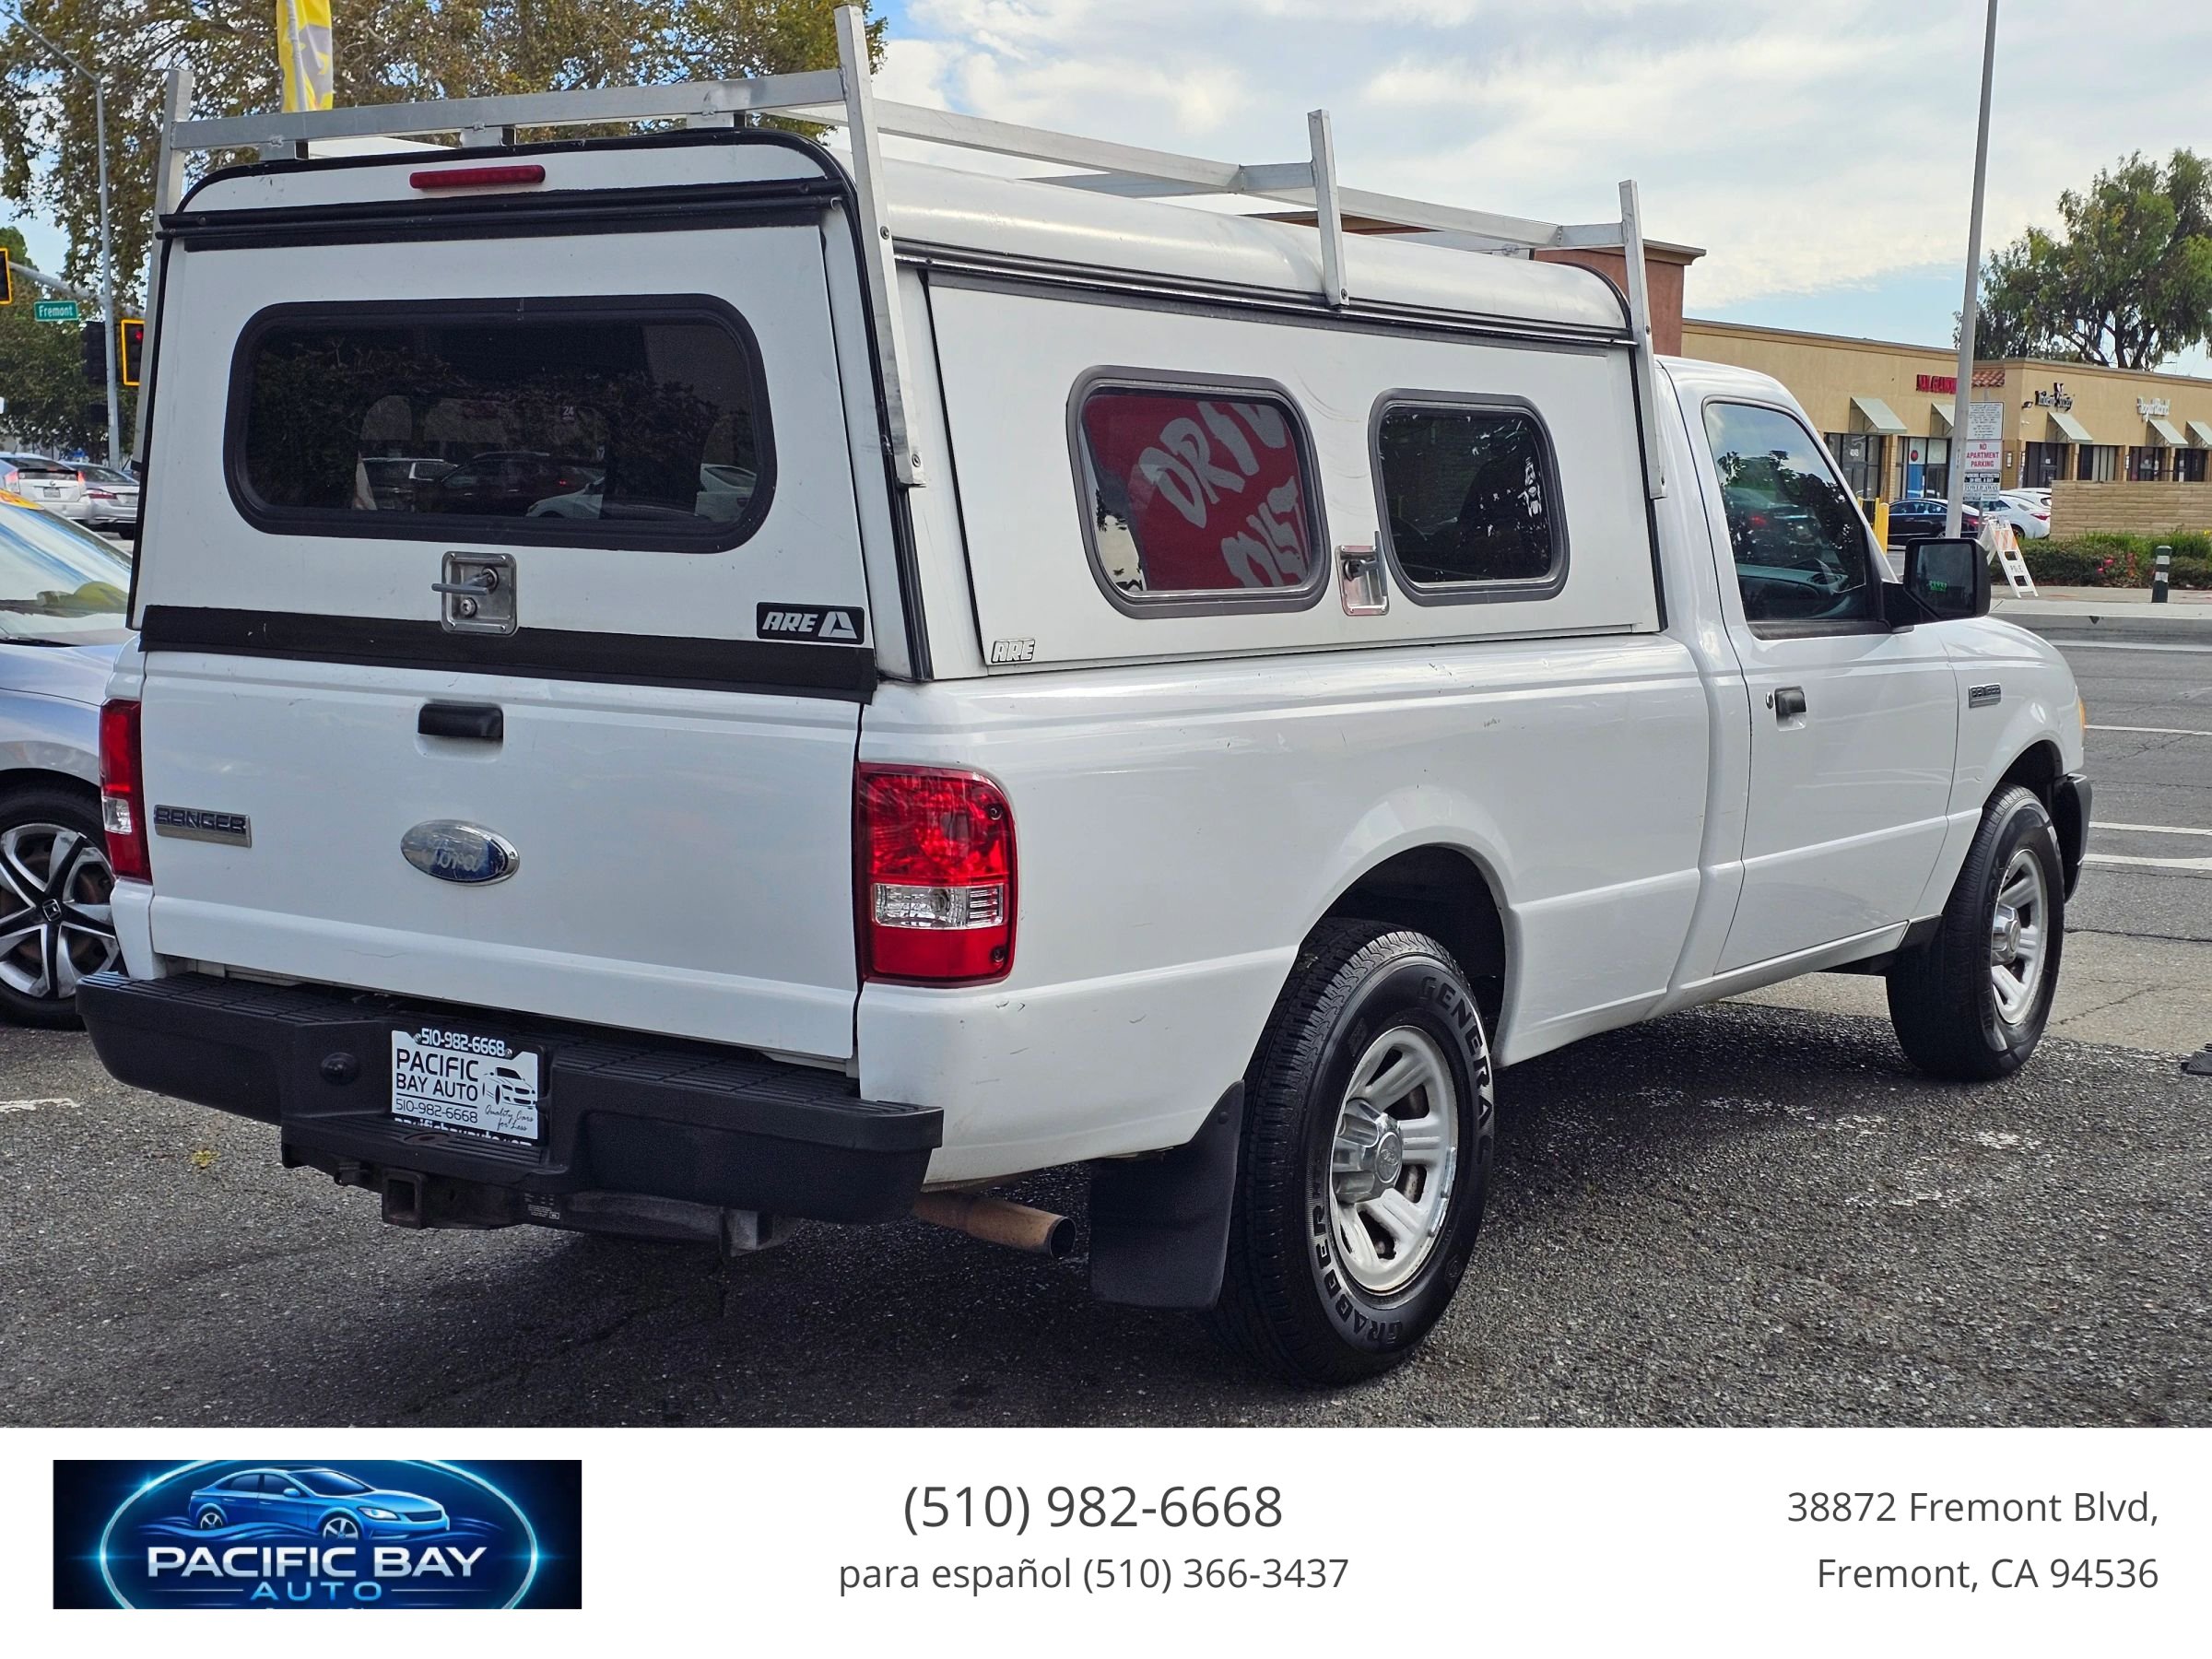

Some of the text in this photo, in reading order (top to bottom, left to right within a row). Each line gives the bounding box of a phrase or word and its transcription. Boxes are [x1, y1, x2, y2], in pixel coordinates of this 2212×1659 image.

[38, 304, 74, 317] Fremont
[762, 611, 819, 632] ARE
[991, 639, 1035, 663] ARE
[154, 807, 247, 835] RANGER
[427, 837, 482, 872] Ford
[421, 1028, 505, 1057] 510-982-6668
[396, 1048, 479, 1082] PACIFIC
[396, 1072, 478, 1102] BAY AUTO
[395, 1098, 478, 1124] 510-982-6668
[485, 1104, 513, 1121] Quality
[497, 1118, 528, 1131] for Less
